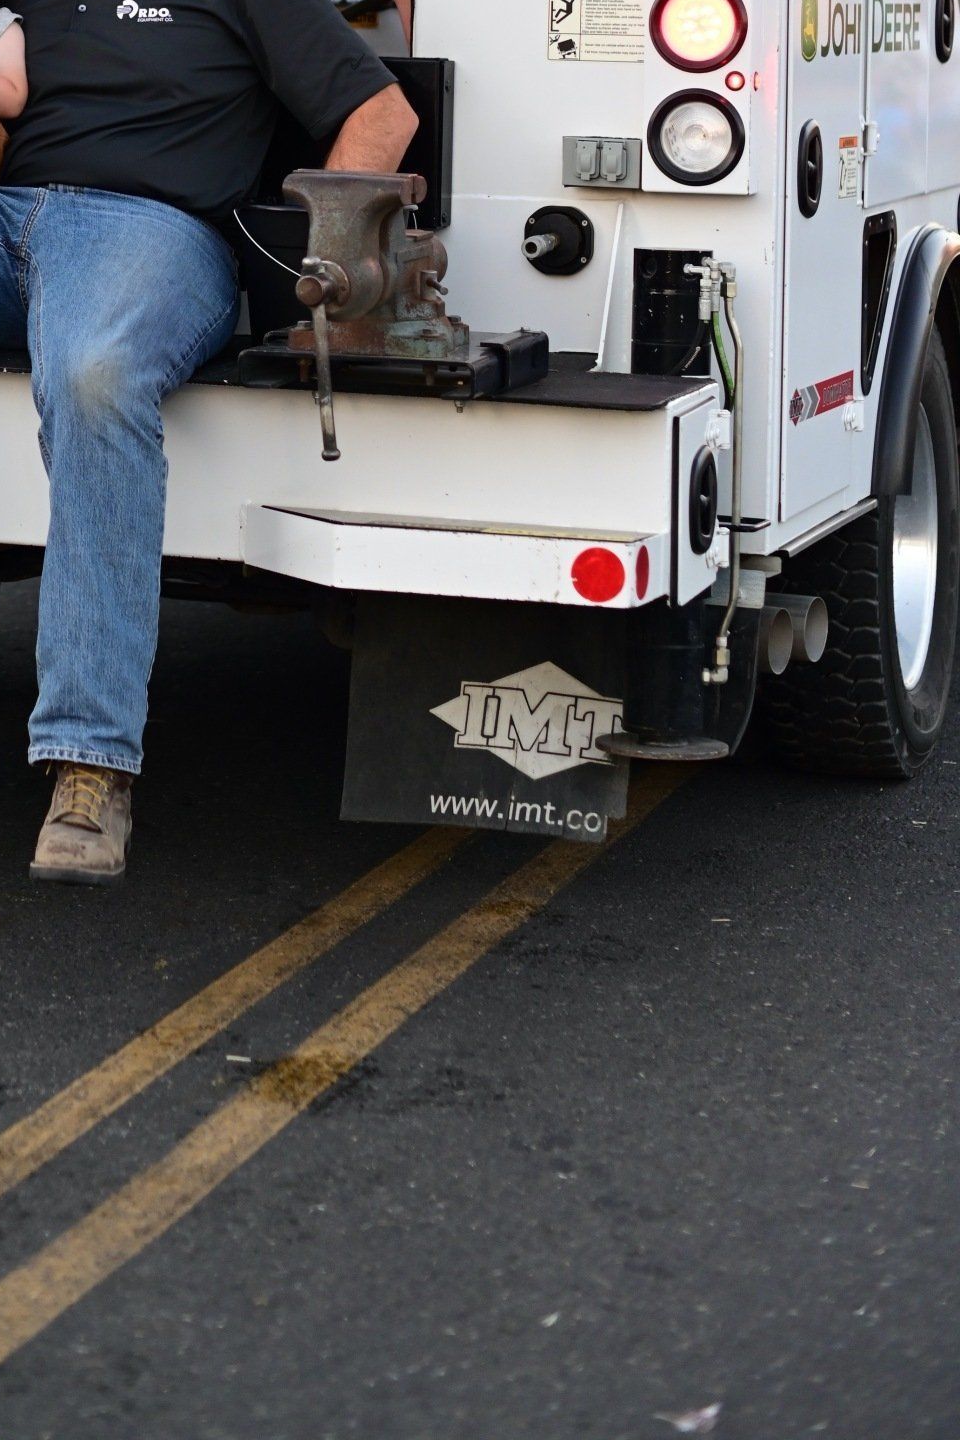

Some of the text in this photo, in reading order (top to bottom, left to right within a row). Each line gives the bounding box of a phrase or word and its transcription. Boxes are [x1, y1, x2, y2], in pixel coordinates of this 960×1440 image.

[138, 7, 171, 18] RDO
[455, 683, 624, 762] IMT
[429, 794, 608, 835] www.imt.co
